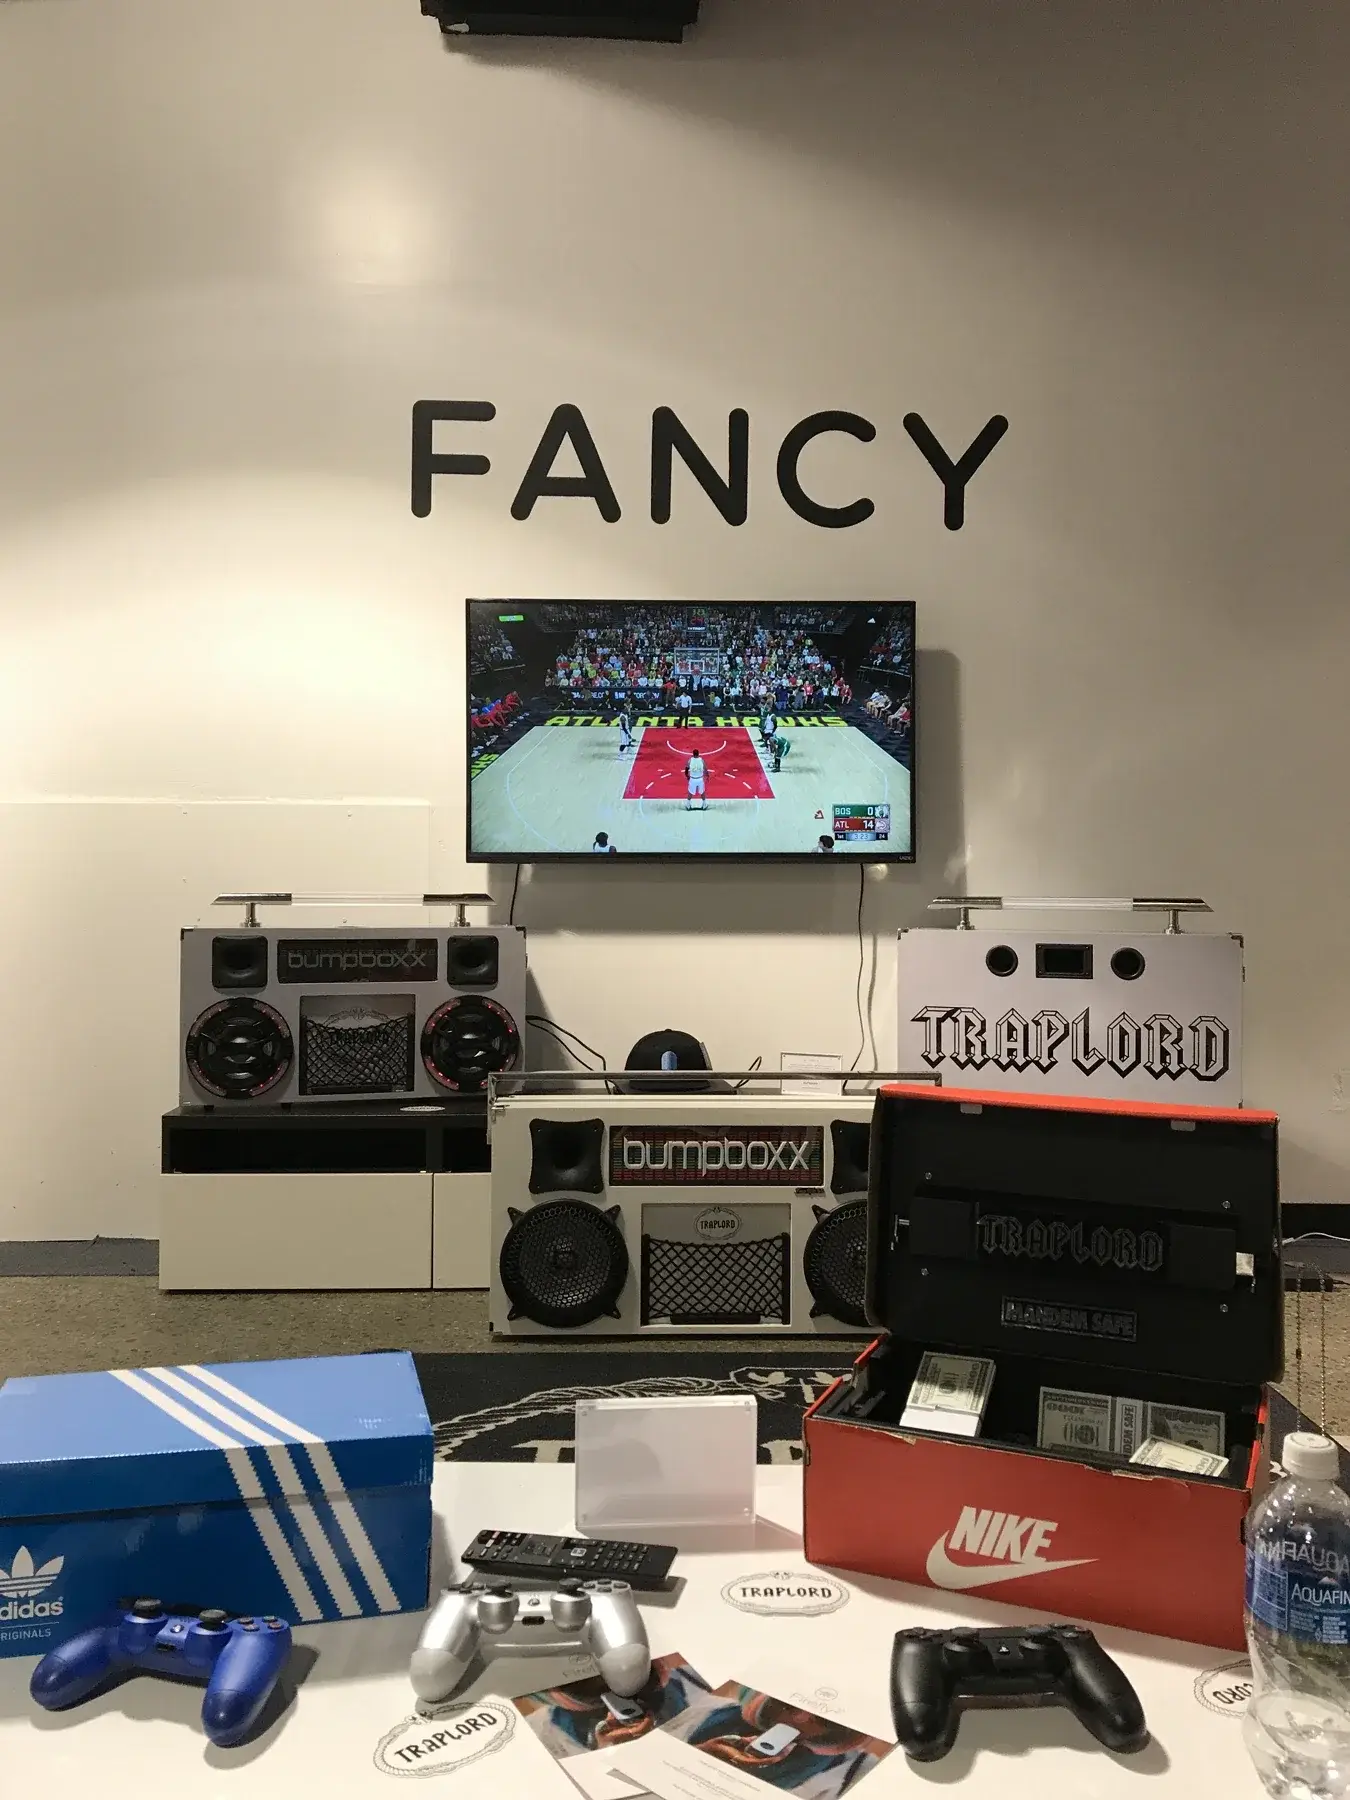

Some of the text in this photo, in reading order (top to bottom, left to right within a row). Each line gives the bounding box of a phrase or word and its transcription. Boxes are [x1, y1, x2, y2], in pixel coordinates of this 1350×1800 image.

[411, 400, 1009, 531] FANCY
[835, 807, 874, 815] BOS 0
[834, 820, 874, 829] ATL 14
[288, 949, 427, 971] bumpboxx
[910, 1006, 1230, 1082] TRAPLORD
[624, 1137, 809, 1177] bumpboxx
[700, 1219, 736, 1230] TRAPLORD
[977, 1214, 1164, 1272] TRAPLORD
[1091, 1312, 1134, 1336] SAFE
[1123, 1406, 1134, 1428] SAFE
[948, 1505, 1058, 1563] NIKE
[740, 1587, 832, 1598] TRAPLORD
[1291, 1584, 1350, 1606] AQUAFIN
[0, 1600, 64, 1620] didas
[0, 1629, 51, 1640] RIGINALS
[394, 1713, 497, 1763] TRAPLORD
